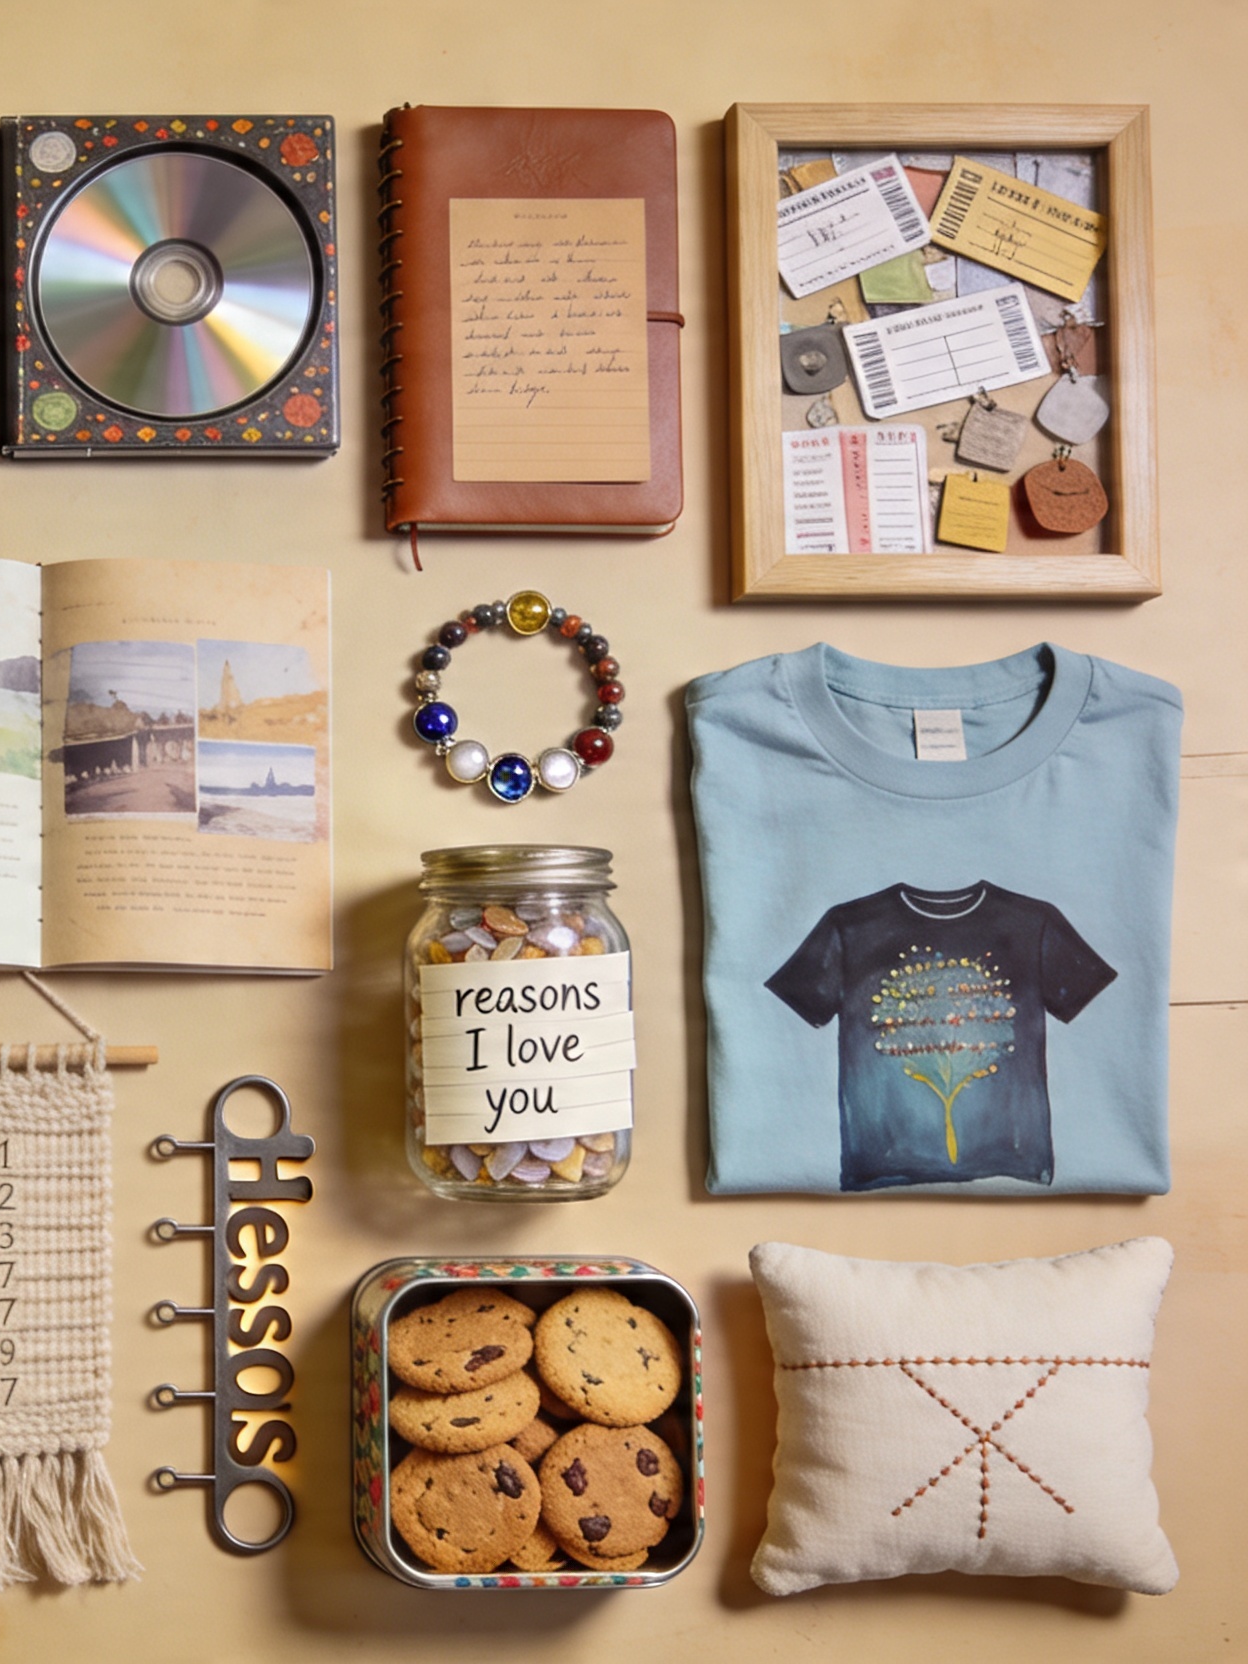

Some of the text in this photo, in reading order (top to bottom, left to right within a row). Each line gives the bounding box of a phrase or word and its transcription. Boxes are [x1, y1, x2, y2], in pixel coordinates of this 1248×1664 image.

[455, 981, 601, 1017] reasons
[465, 1023, 585, 1072] I love
[484, 1085, 559, 1134] you
